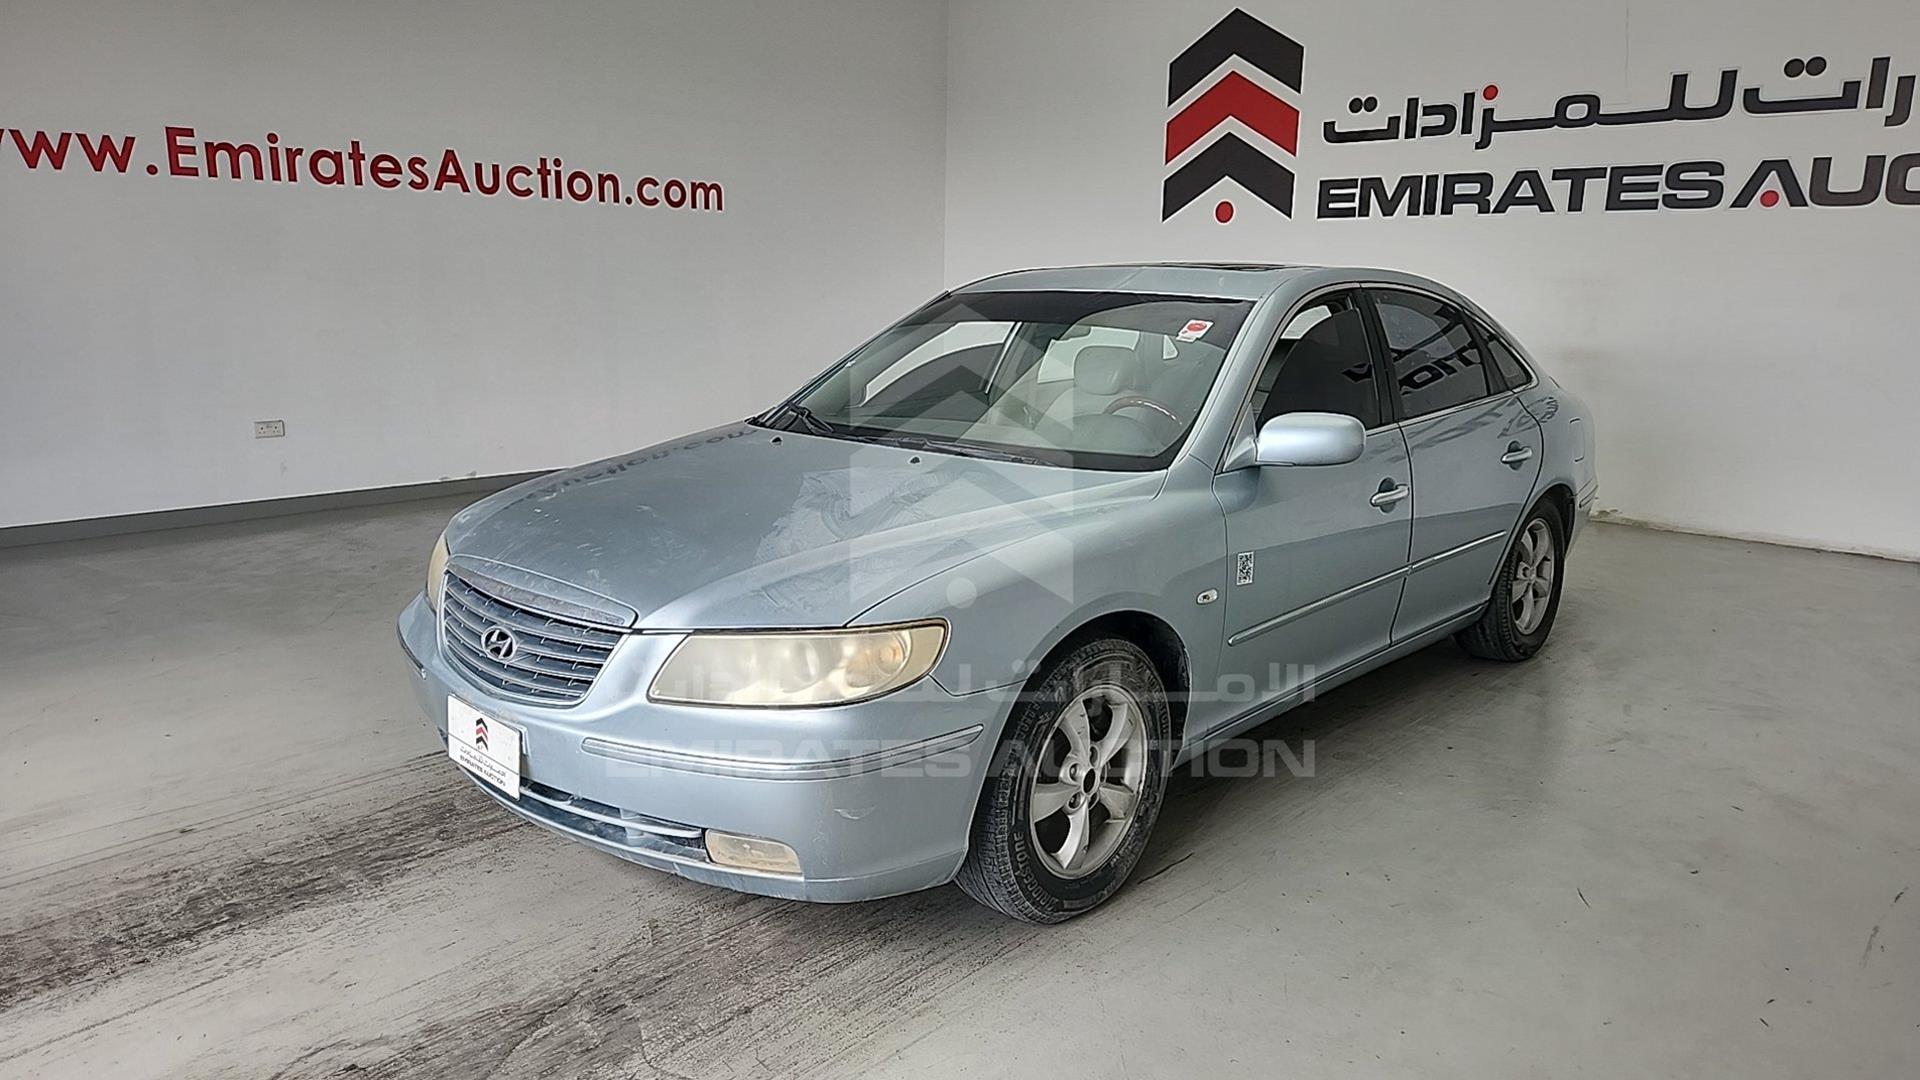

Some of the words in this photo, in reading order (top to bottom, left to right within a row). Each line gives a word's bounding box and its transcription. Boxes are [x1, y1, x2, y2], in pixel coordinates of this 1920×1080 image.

[1323, 70, 1738, 149] للمزادات
[0, 126, 725, 211] ww.EmiratesAuction.com
[1317, 162, 1725, 218] EMIRATES
